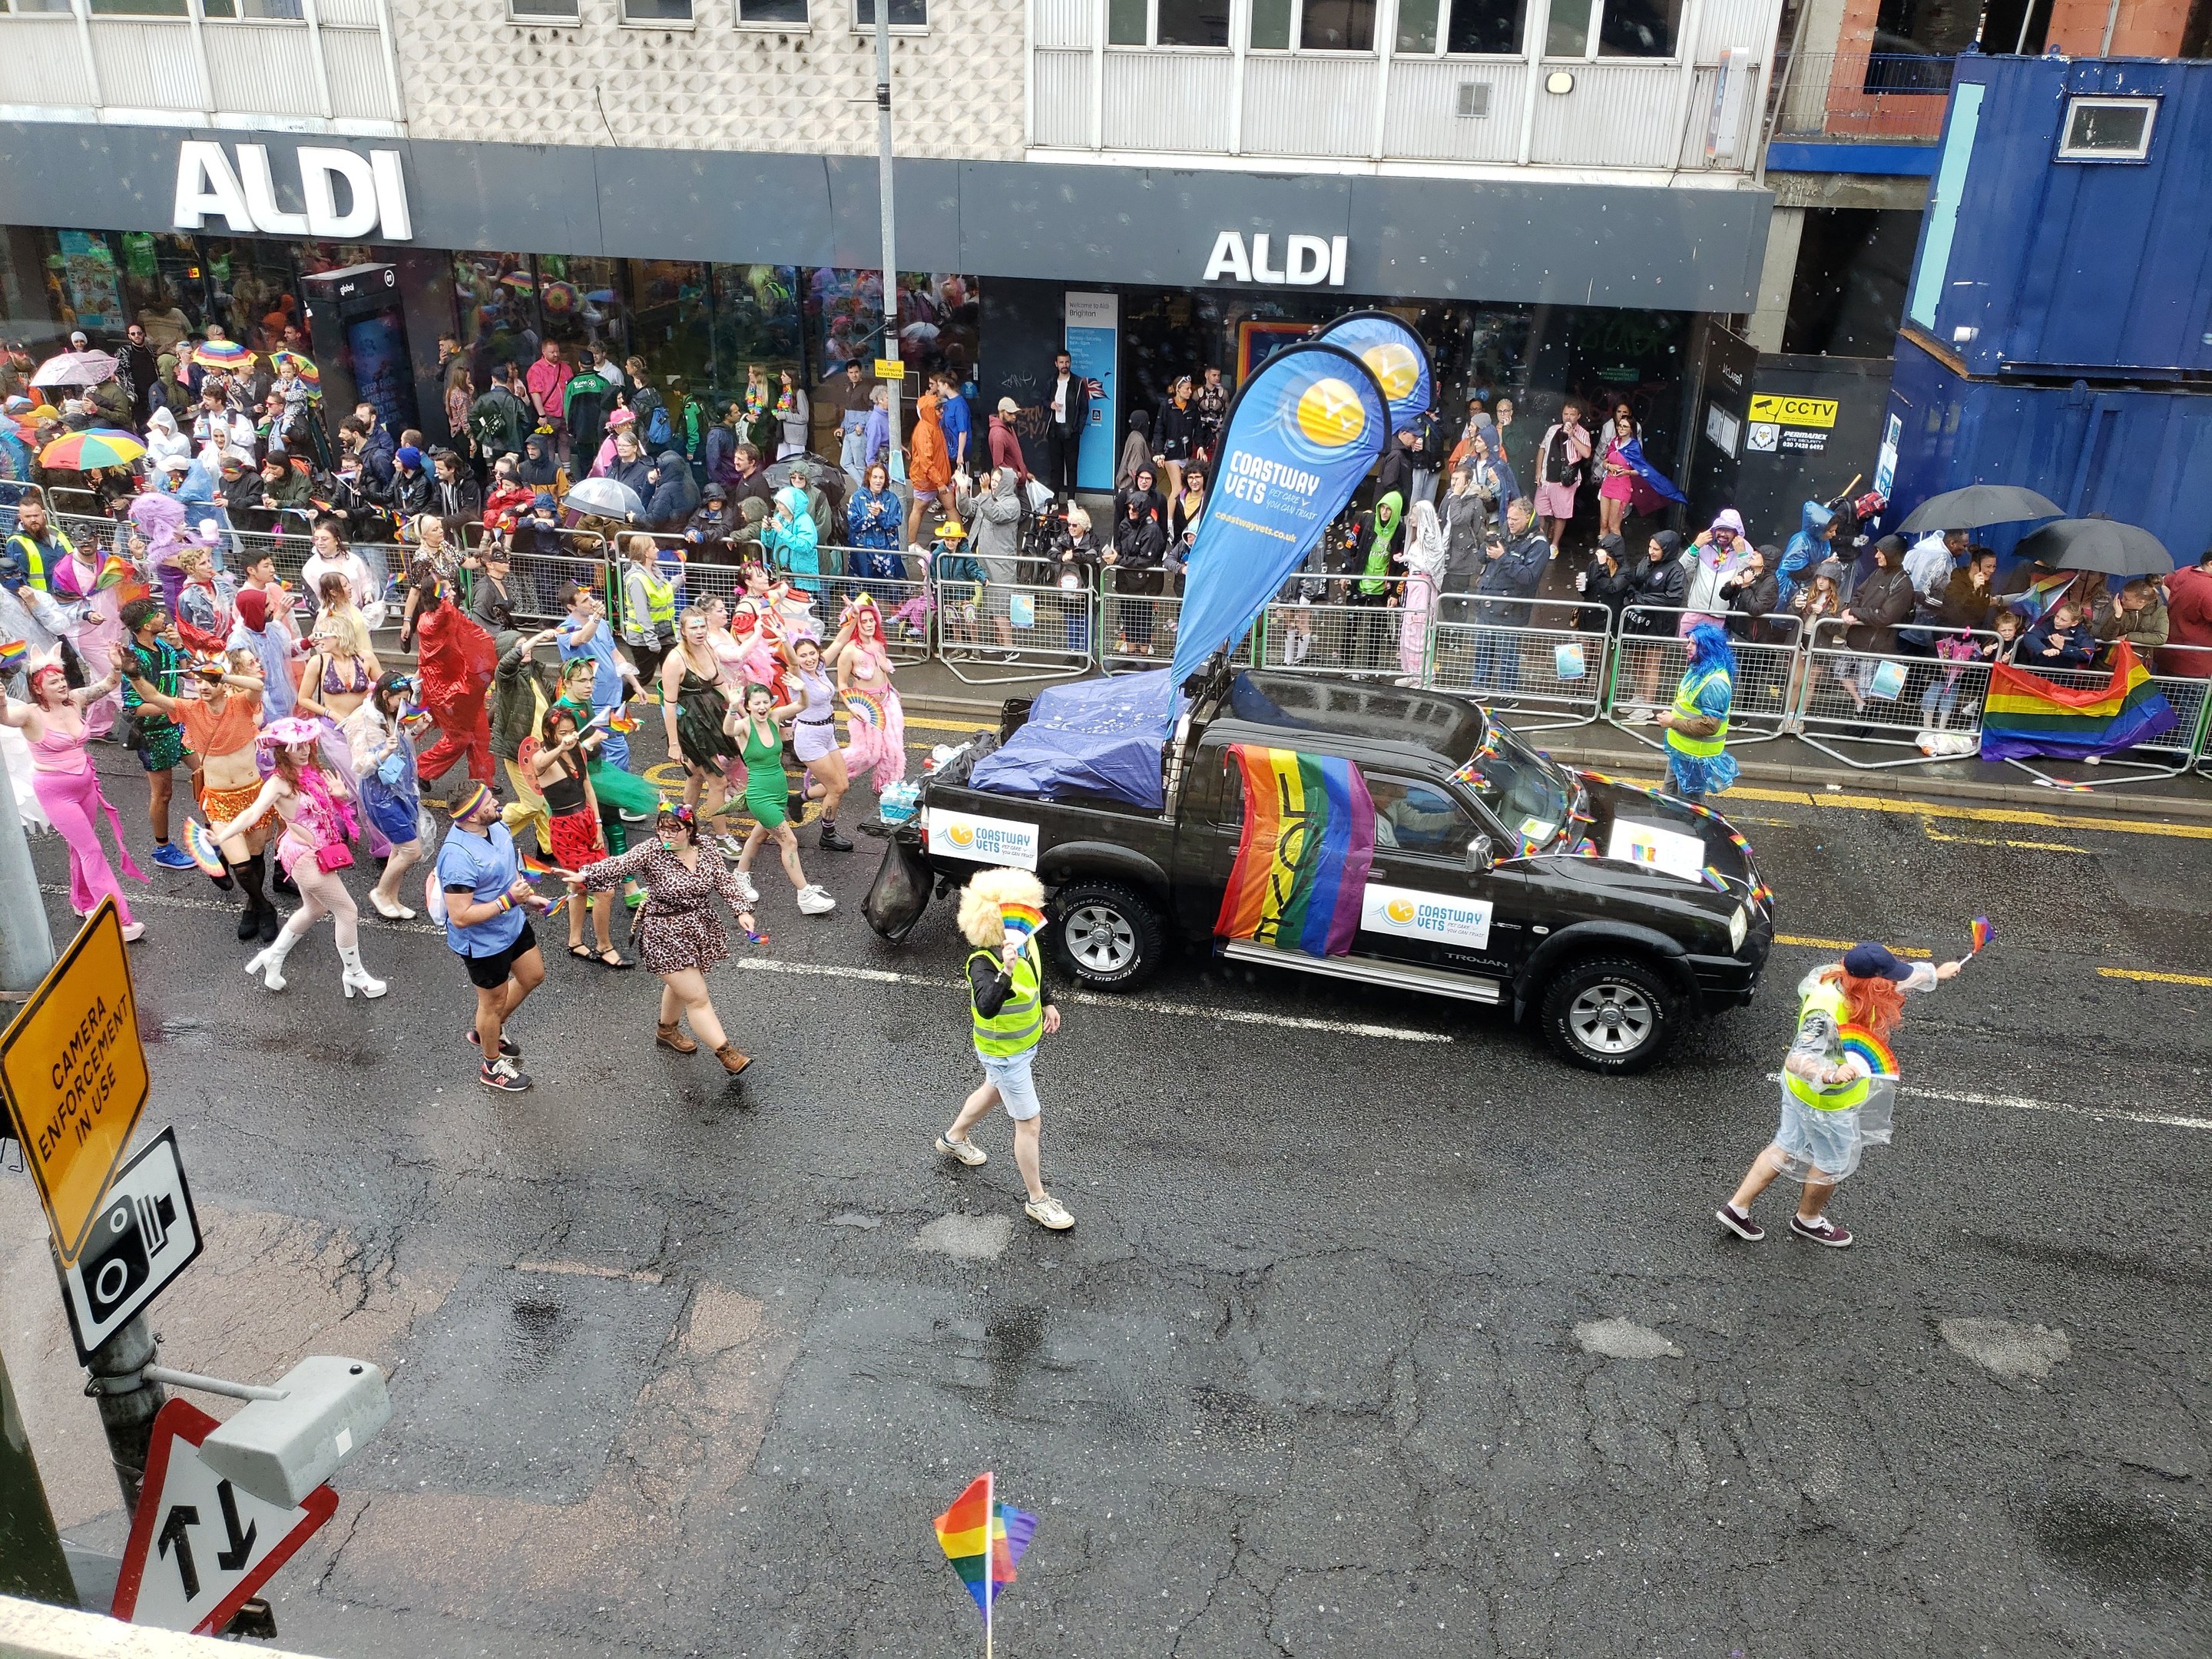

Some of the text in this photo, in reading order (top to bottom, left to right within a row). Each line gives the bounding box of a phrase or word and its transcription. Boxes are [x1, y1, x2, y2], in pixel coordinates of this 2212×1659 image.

[174, 141, 413, 240] ALDI
[1204, 231, 1349, 286] ALDI
[339, 283, 355, 296] global
[1785, 401, 1835, 416] CCTV
[1230, 450, 1320, 497] COASTWAY
[1224, 473, 1267, 505] VETS
[1269, 488, 1301, 504] PET CARE
[1280, 502, 1296, 514] CAN
[1296, 507, 1319, 521] TRUST
[1215, 511, 1297, 543] coastwayvets.co.uk
[976, 827, 1031, 846] COASTWAY
[977, 839, 1000, 853] VETS
[1417, 917, 1445, 931] VETS
[1418, 905, 1482, 925] COASTWAY
[1444, 952, 1508, 969] TROJAN
[51, 995, 107, 1091] CAMERA
[38, 993, 130, 1163] ENFORCEMENT
[75, 1062, 117, 1147] IN USE
